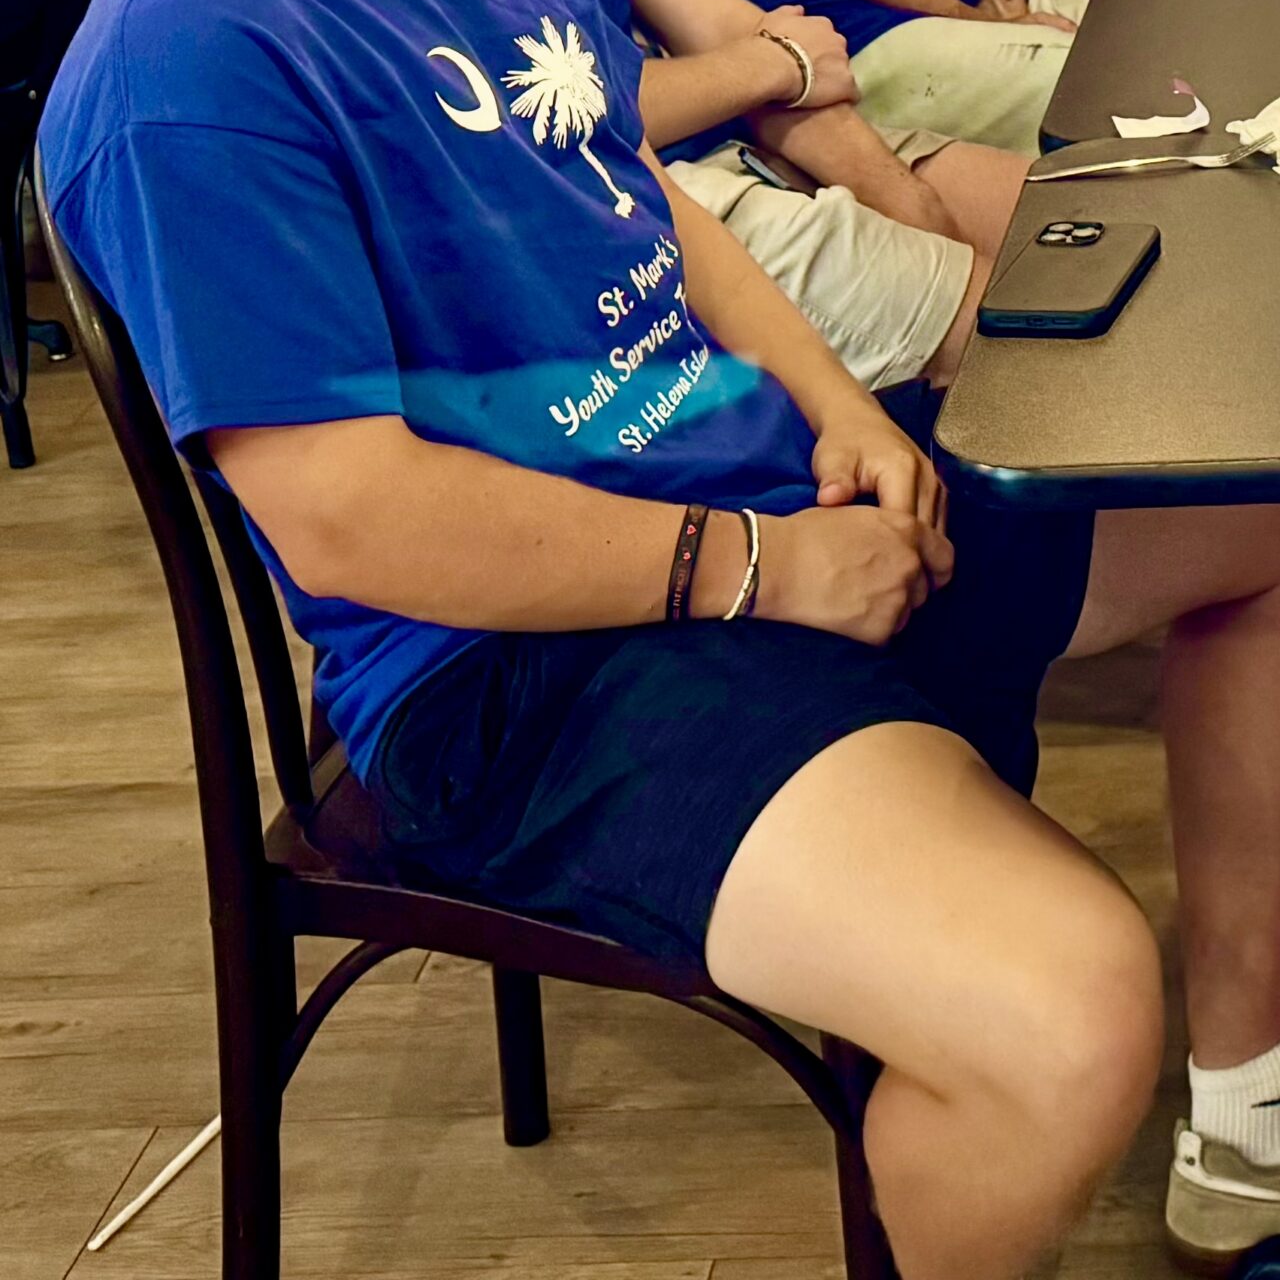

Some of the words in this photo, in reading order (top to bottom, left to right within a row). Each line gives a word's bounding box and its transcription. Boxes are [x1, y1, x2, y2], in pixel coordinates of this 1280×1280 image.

[597, 286, 634, 327] St.
[629, 234, 679, 301] Mark's
[548, 369, 618, 437] Youth
[609, 310, 682, 383] Service
[617, 423, 652, 453] St.
[639, 375, 692, 433] Helena
[679, 343, 709, 384] Isla
